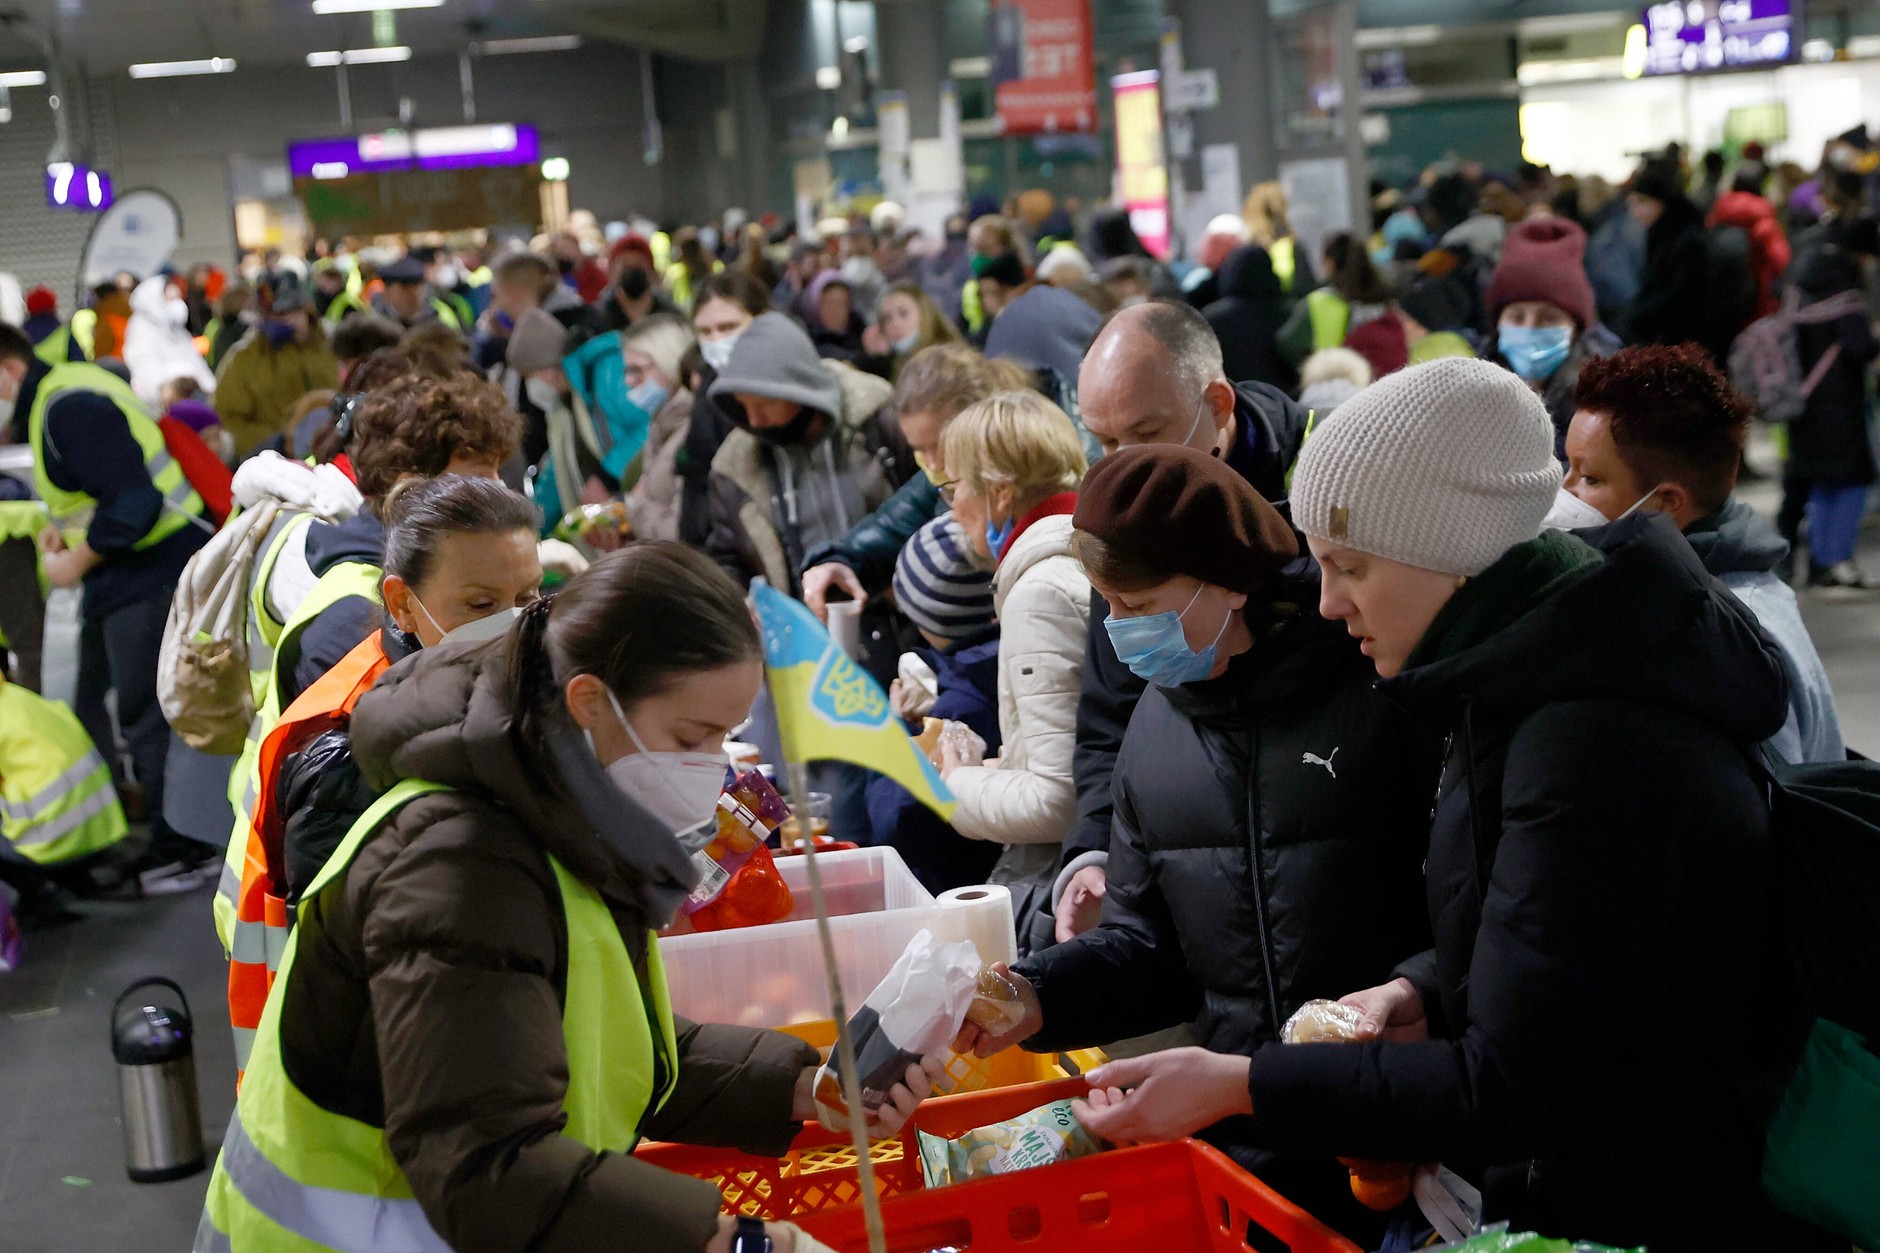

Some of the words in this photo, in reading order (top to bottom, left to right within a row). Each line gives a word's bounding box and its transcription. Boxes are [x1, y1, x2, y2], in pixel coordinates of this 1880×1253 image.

[1051, 1107, 1070, 1126] eco
[1000, 1155, 1016, 1172] NAT
[1012, 1148, 1032, 1169] KRO
